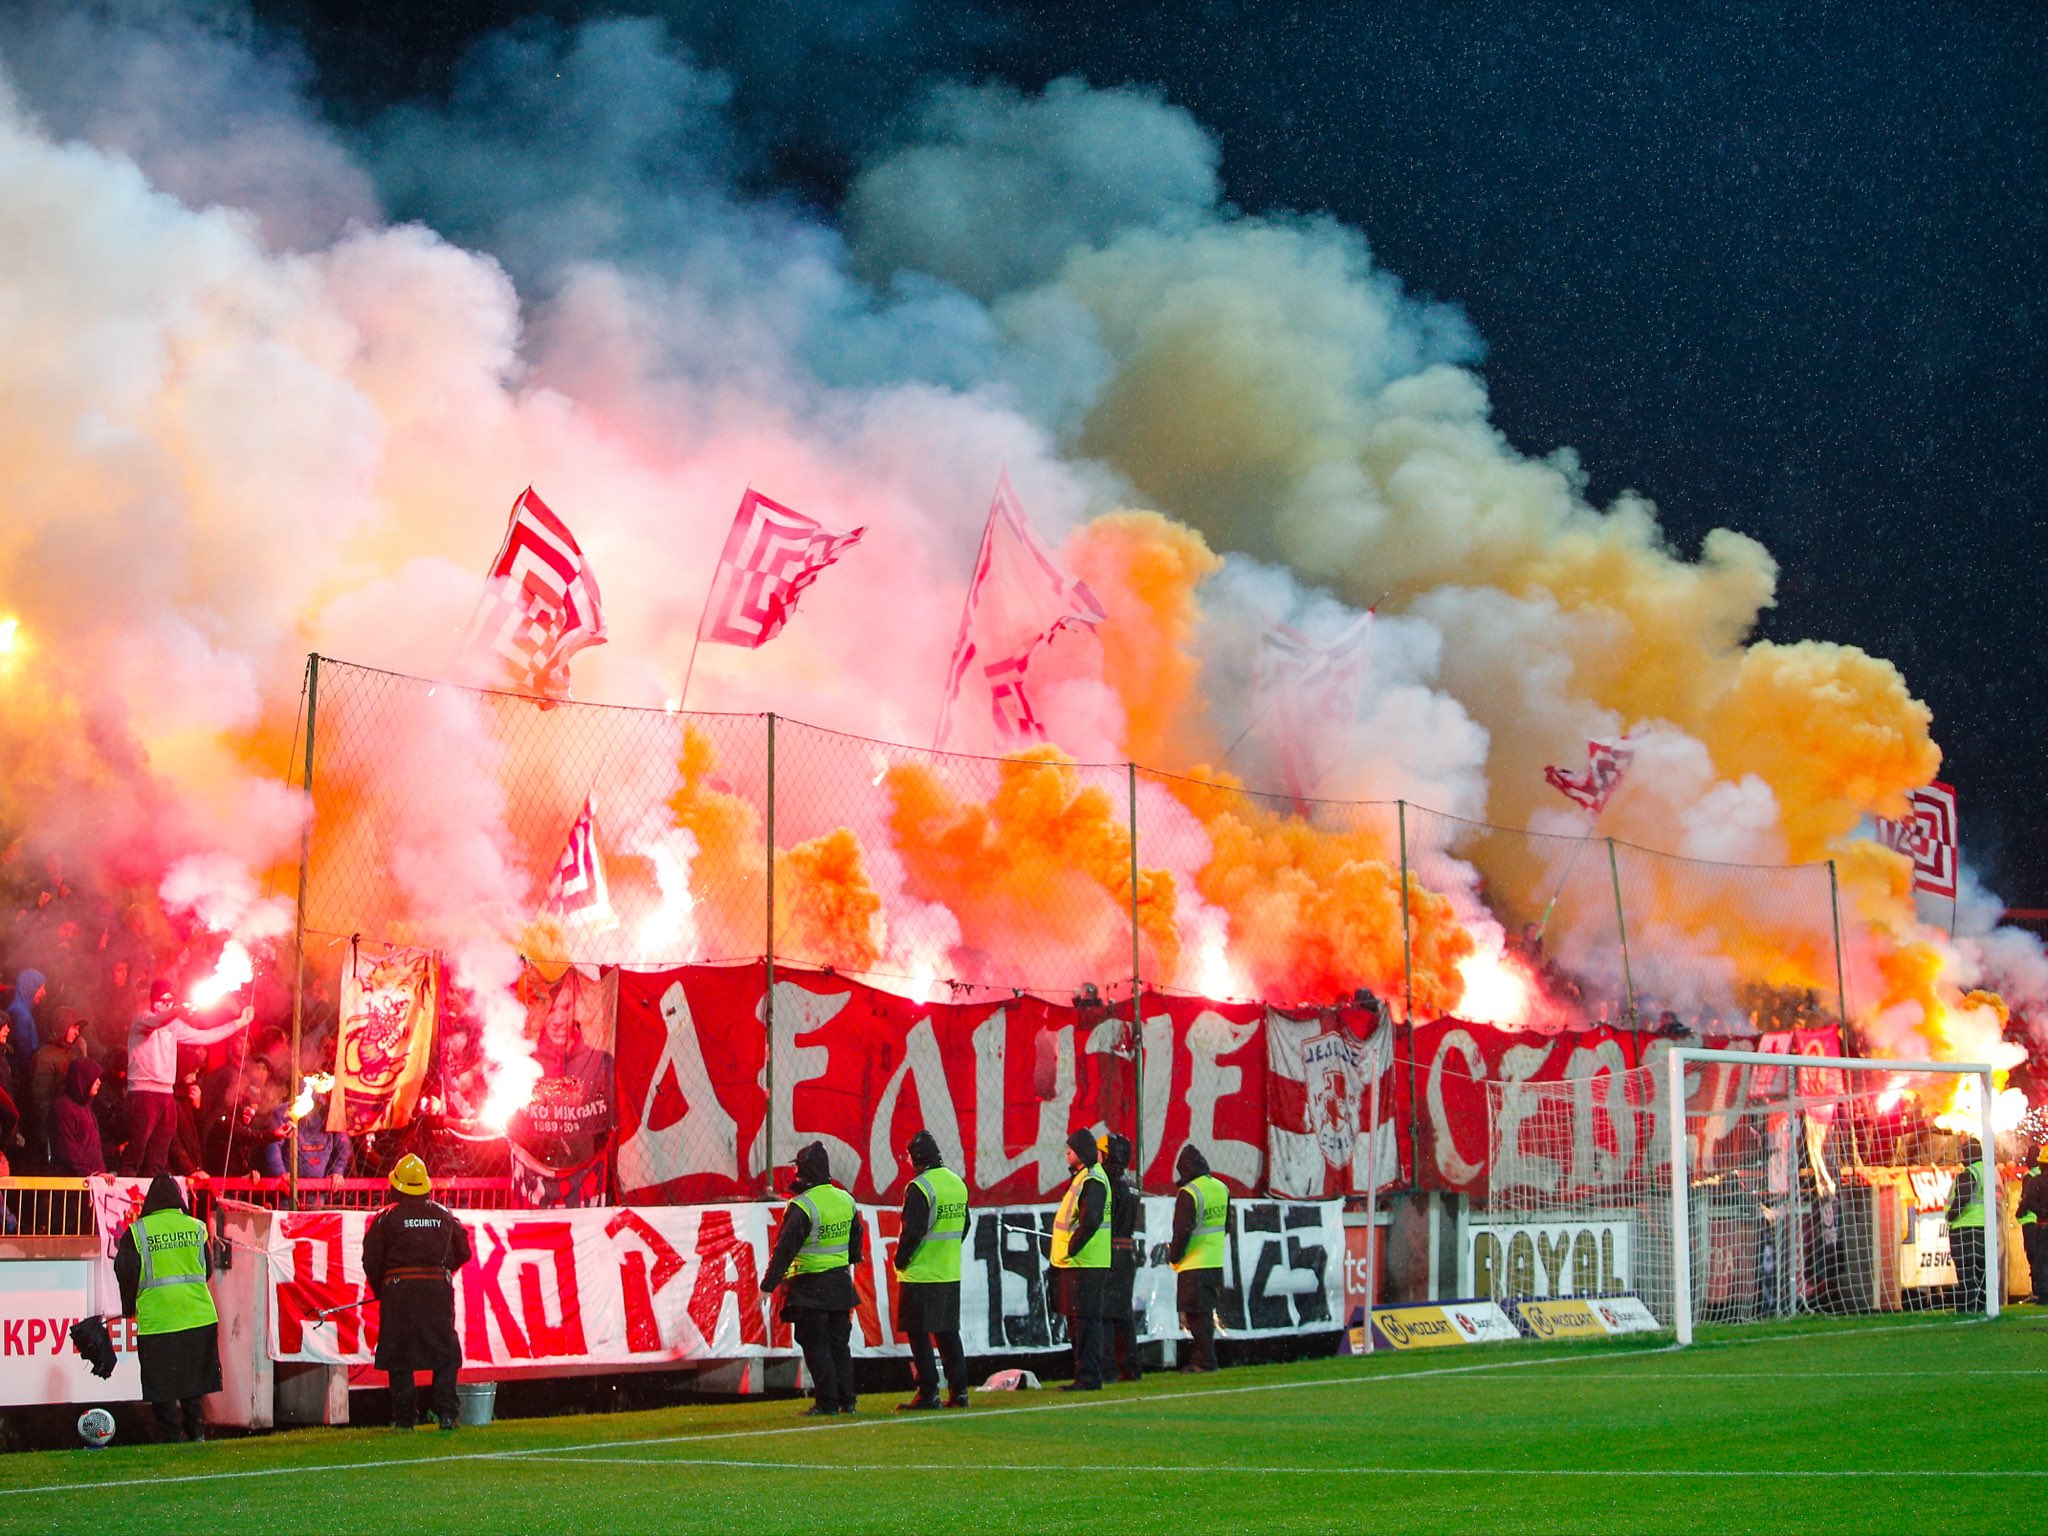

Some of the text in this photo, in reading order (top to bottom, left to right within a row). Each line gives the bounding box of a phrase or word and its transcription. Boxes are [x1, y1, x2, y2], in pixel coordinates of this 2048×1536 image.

[404, 1218, 441, 1229] SECURITY
[146, 1230, 200, 1245] SECURITY
[1550, 1313, 1597, 1327] MOZZART
[1405, 1320, 1453, 1336] MOZZART
[3, 1317, 138, 1356] КРУЕВ
